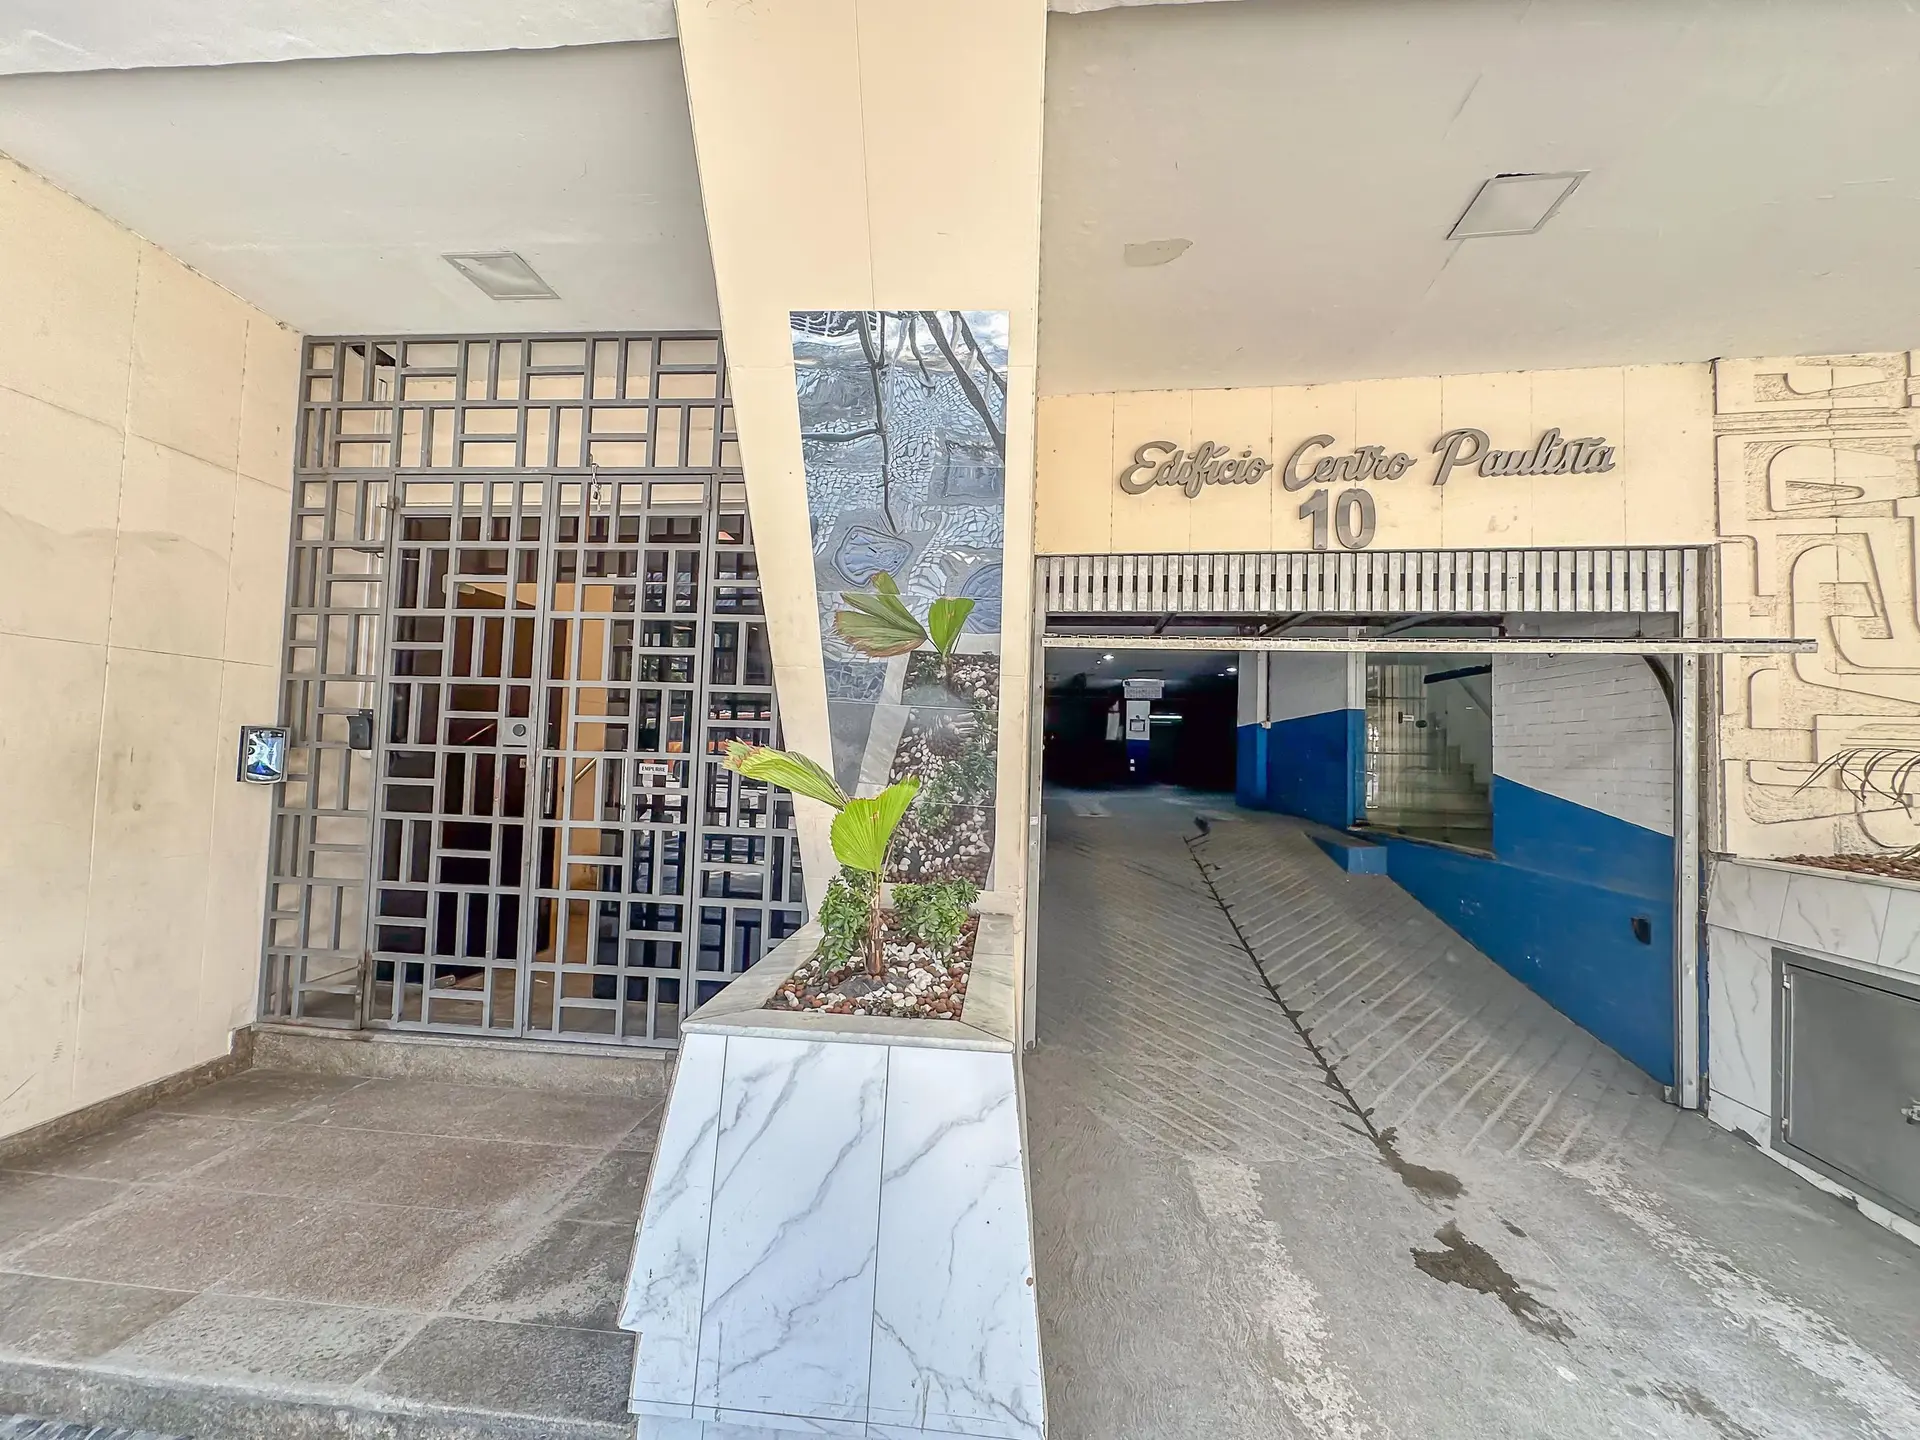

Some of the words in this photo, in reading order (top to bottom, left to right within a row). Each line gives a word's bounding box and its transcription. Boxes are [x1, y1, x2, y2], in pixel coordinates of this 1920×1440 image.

[1120, 440, 1273, 499] Edifício
[1283, 434, 1418, 492] Centro
[1432, 427, 1616, 486] Paulista
[1299, 488, 1376, 550] 10
